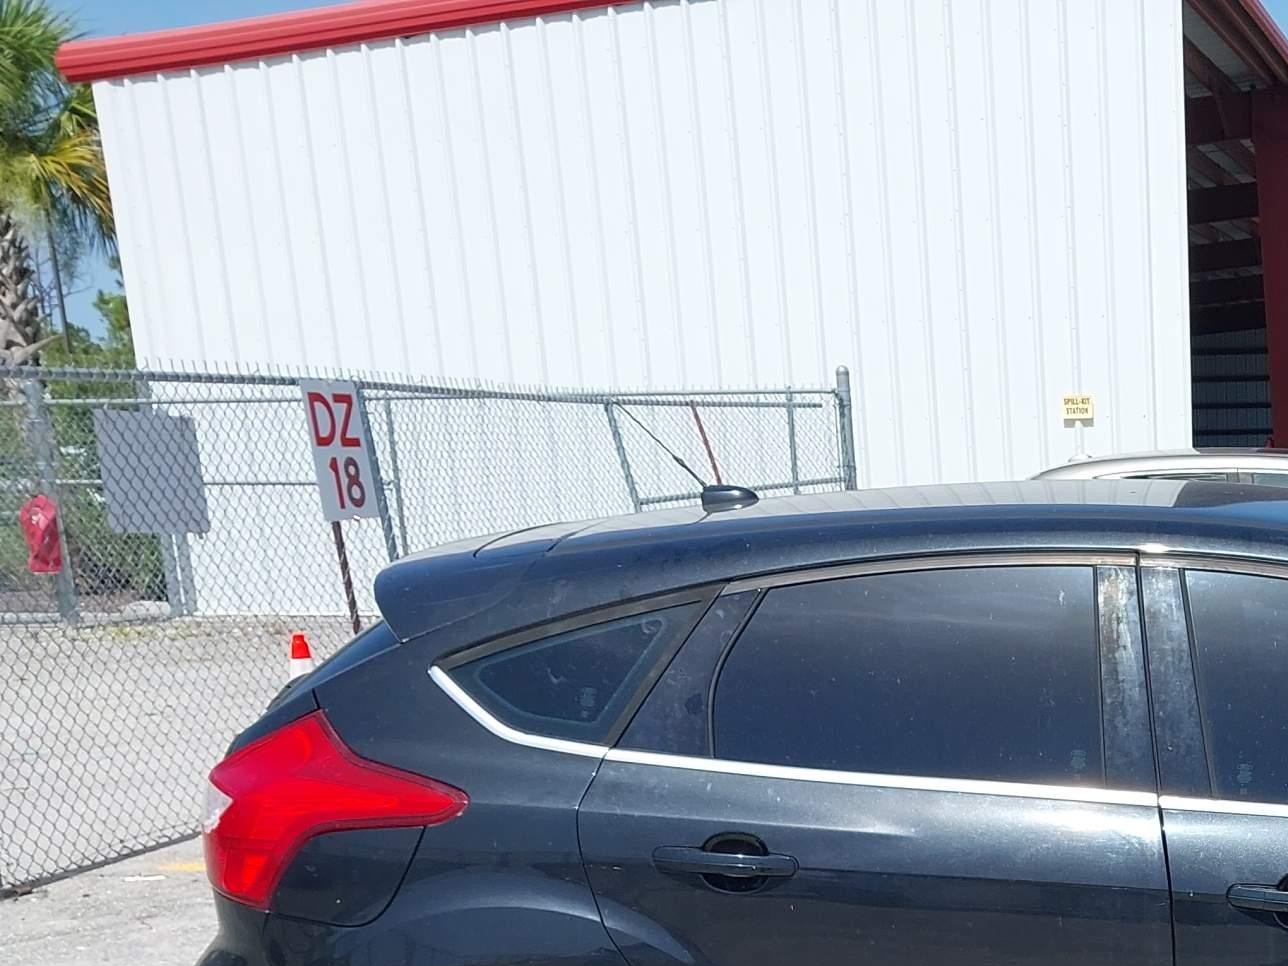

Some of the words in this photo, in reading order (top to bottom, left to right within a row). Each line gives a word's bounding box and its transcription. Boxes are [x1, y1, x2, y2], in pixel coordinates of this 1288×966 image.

[307, 391, 361, 447] DZ
[1065, 406, 1089, 415] STATION
[329, 456, 366, 509] 18
